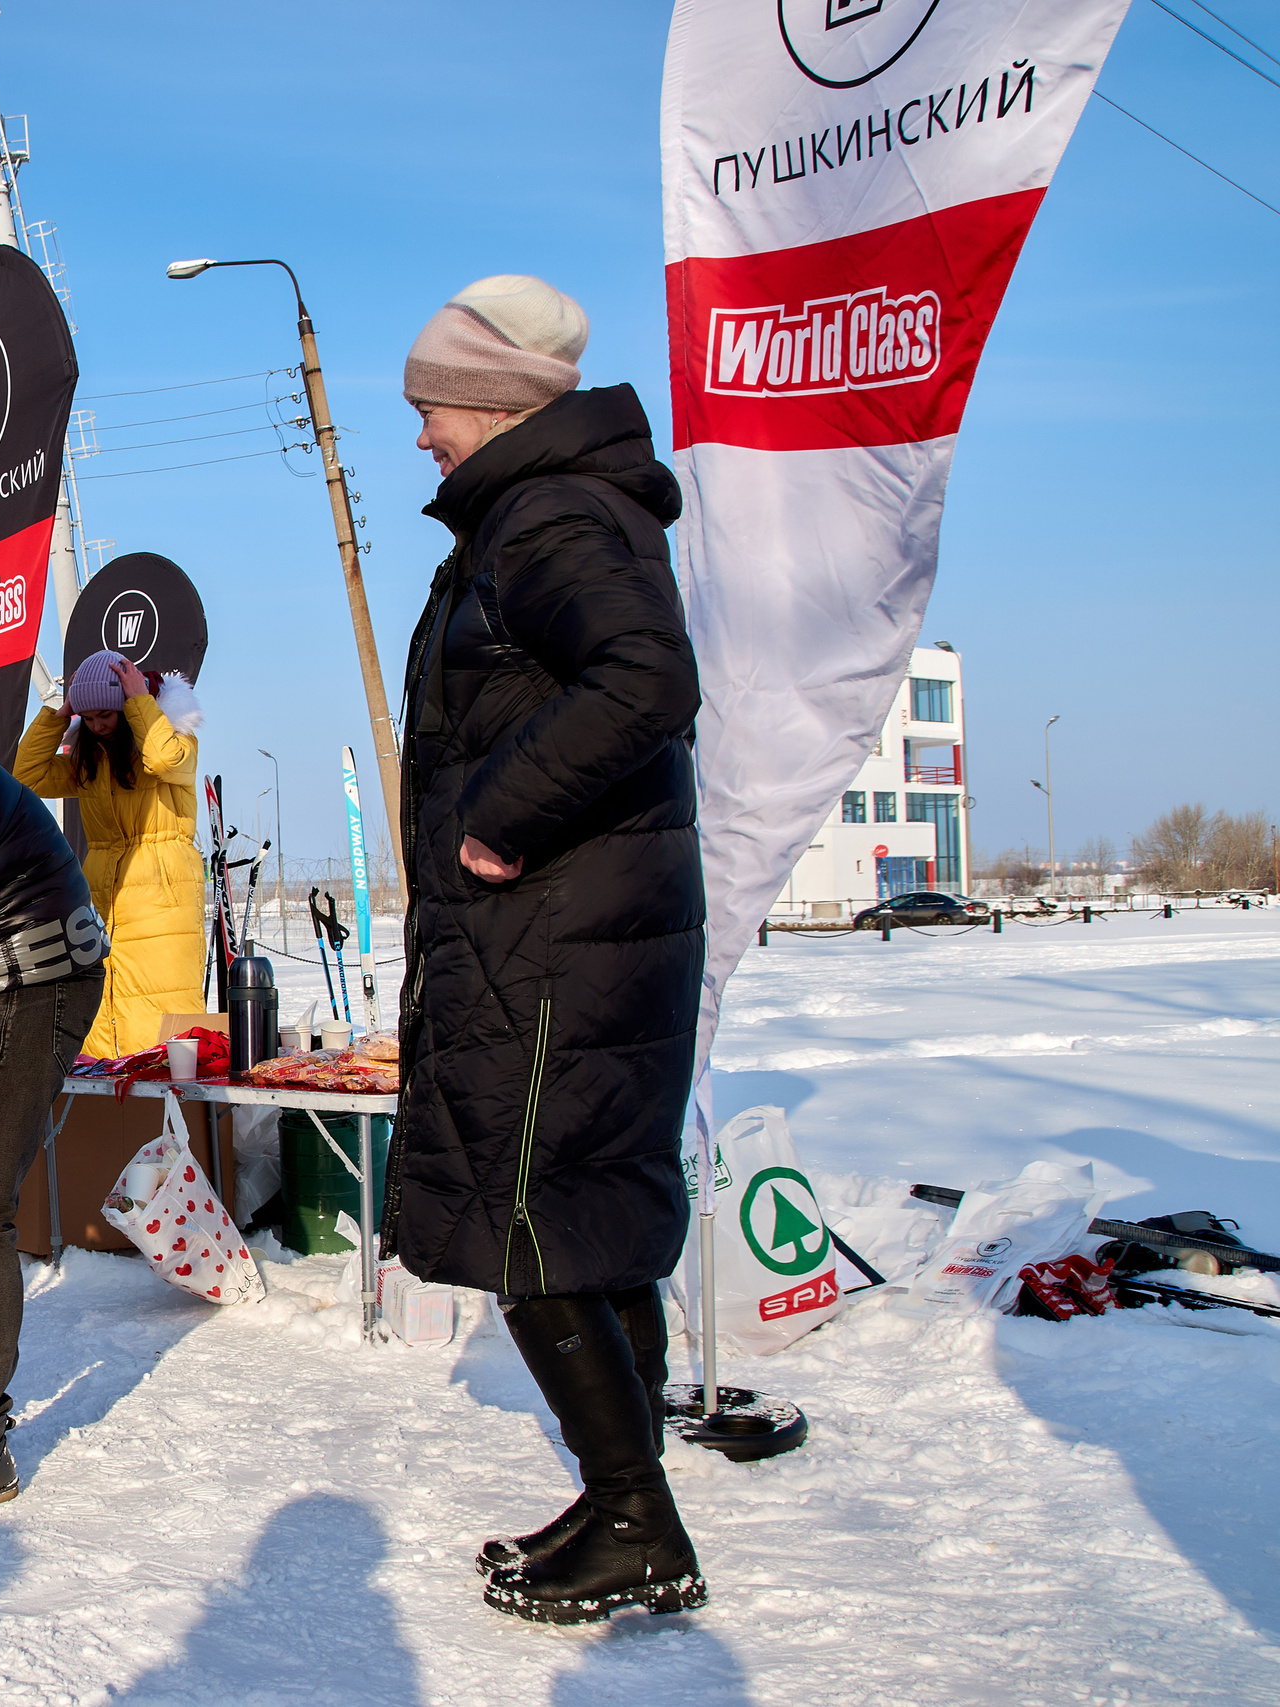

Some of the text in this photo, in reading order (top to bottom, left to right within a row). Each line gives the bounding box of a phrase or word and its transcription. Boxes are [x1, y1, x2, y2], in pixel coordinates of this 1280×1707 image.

[713, 58, 1036, 195] ПУШКИНСКИЙ
[718, 301, 934, 386] World Class
[349, 814, 367, 890] NORDWAY
[337, 957, 347, 996] NORDWAY
